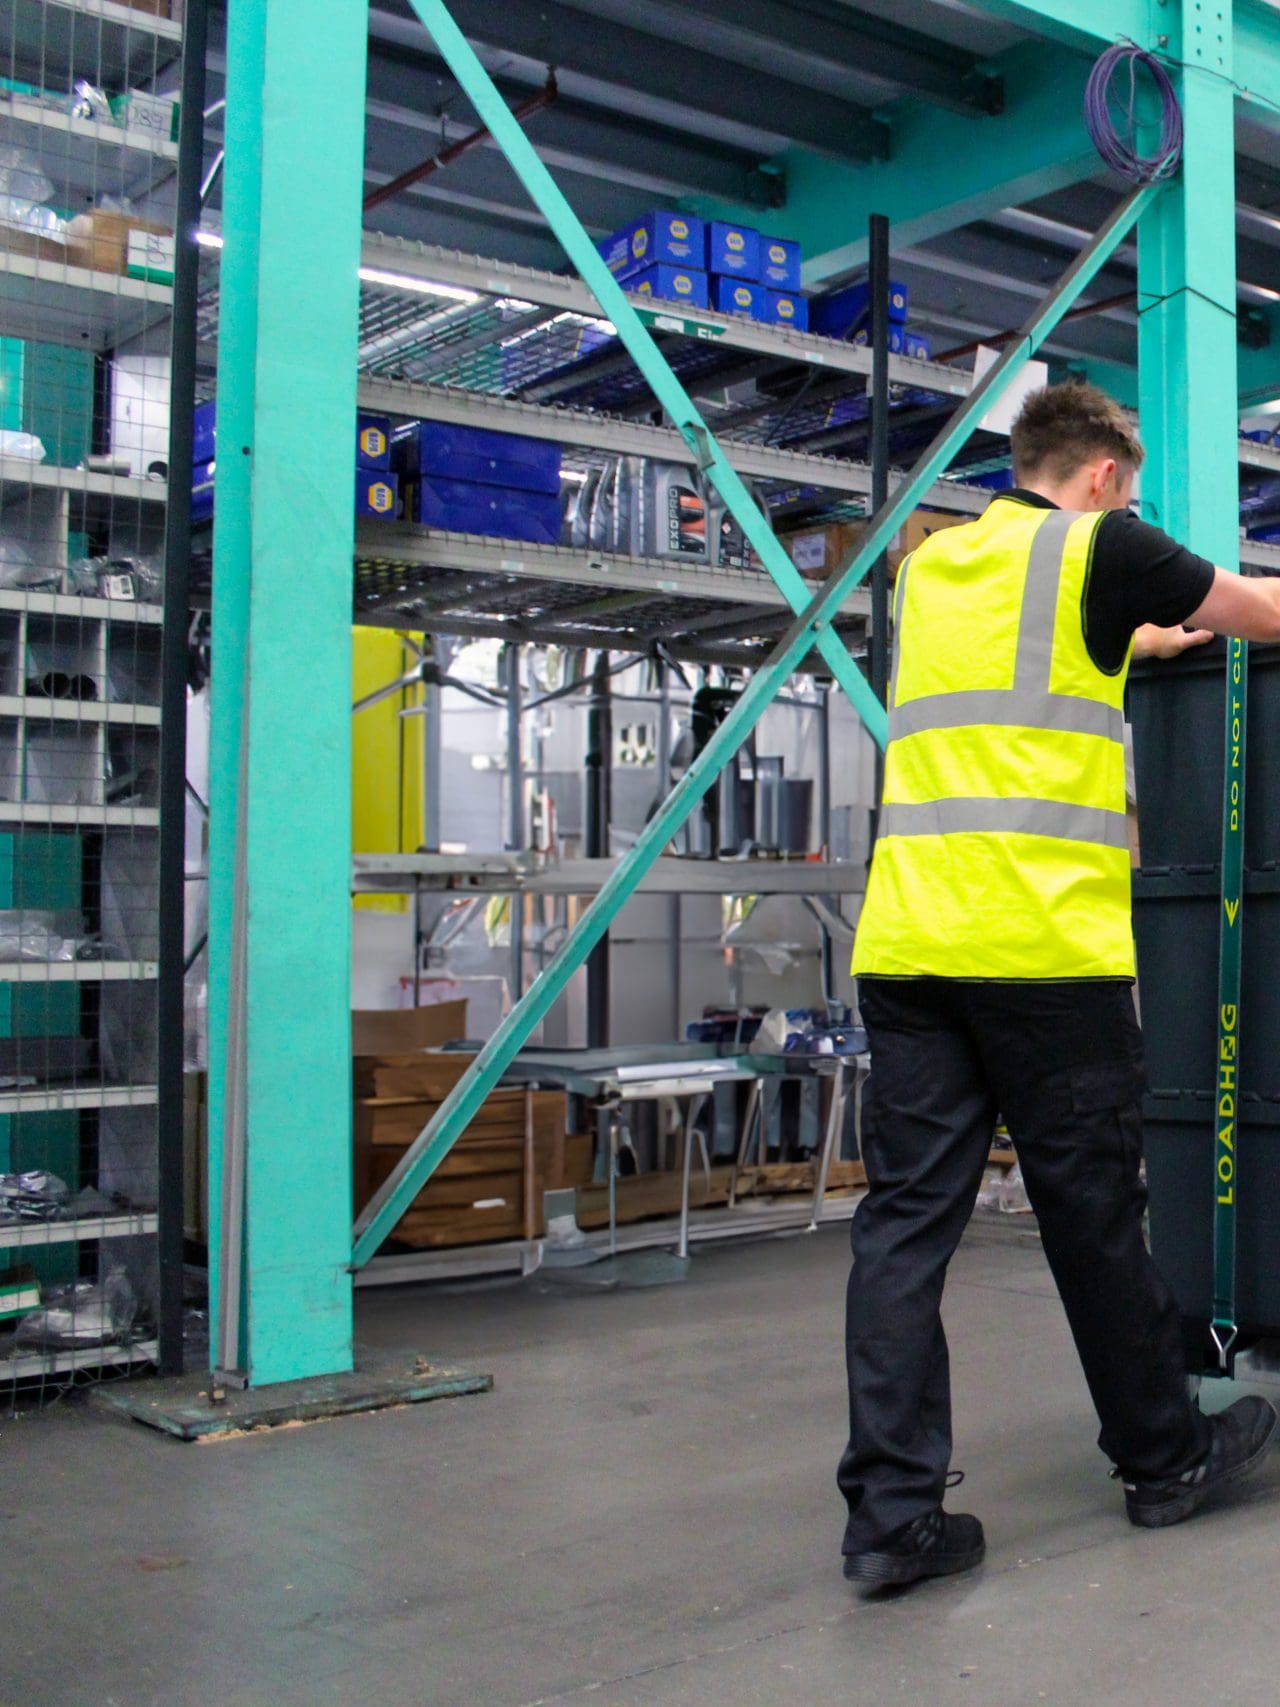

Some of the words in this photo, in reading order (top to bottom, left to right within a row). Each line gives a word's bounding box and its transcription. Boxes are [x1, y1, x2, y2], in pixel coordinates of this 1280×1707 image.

[669, 487, 679, 550] EXOPRO
[1233, 638, 1241, 684] CU
[1232, 696, 1241, 767] NOT
[1230, 781, 1239, 831] DO
